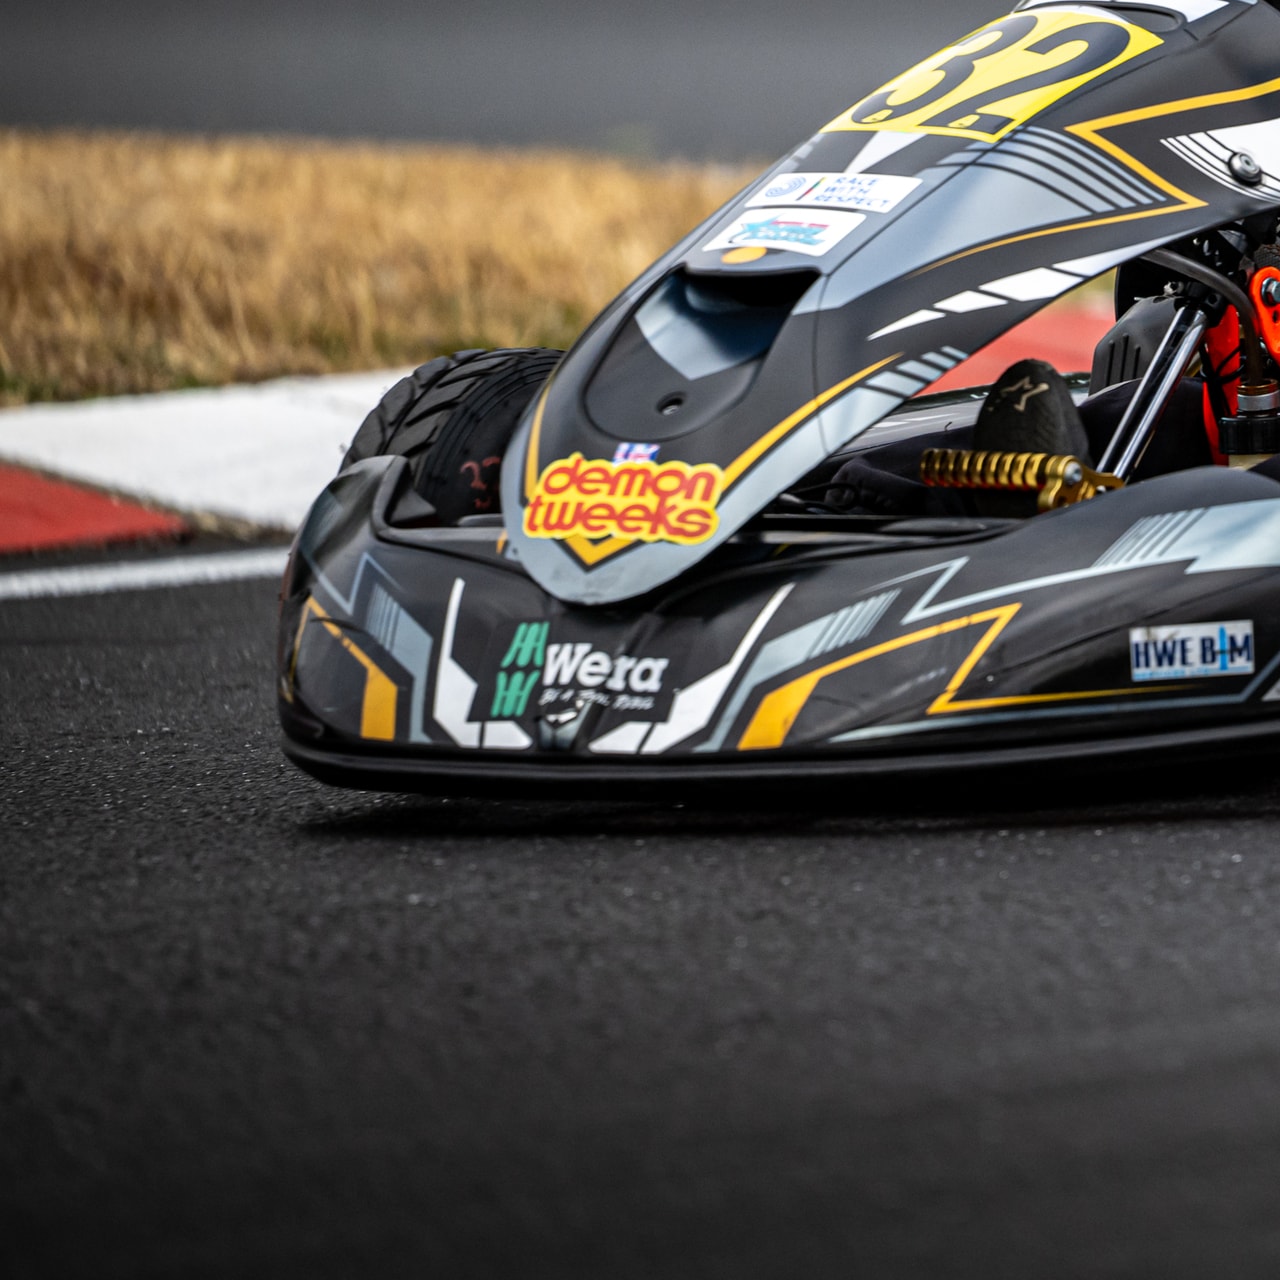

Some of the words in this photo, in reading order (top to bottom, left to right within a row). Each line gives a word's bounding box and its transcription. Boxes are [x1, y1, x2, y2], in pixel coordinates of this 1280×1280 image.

[851, 15, 1131, 133] 32
[543, 457, 716, 502] demon
[526, 495, 713, 538] tweeks
[542, 642, 670, 693] Wera
[1133, 637, 1192, 669] HWE
